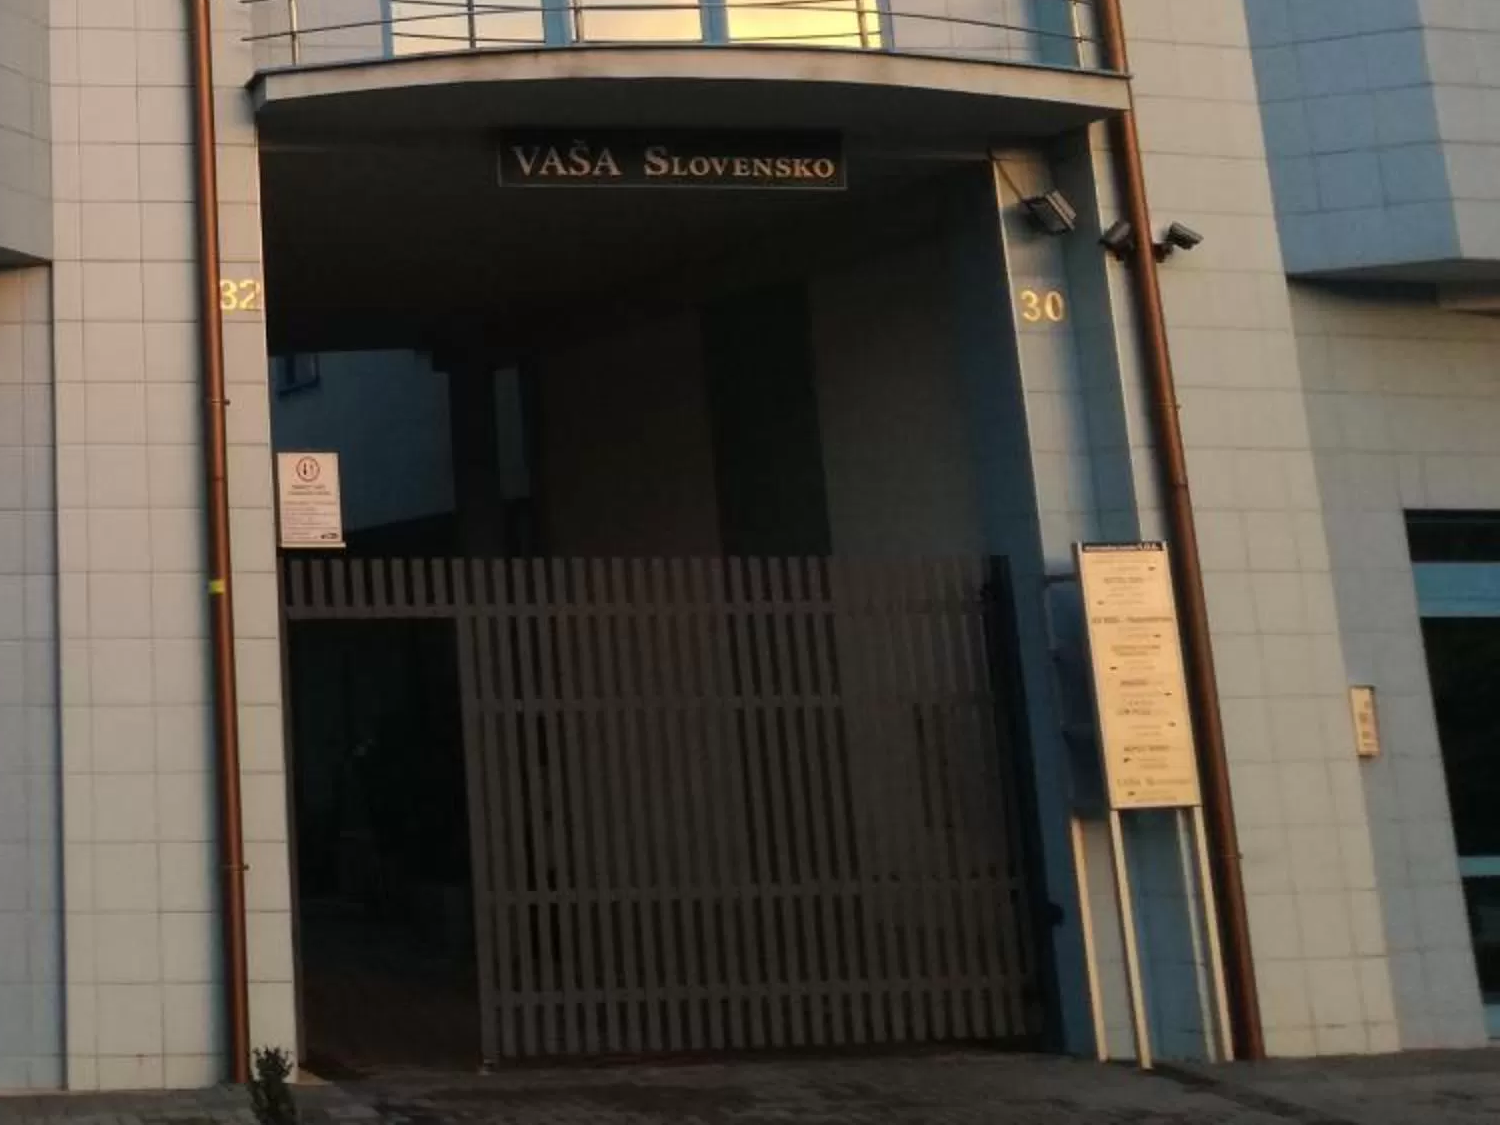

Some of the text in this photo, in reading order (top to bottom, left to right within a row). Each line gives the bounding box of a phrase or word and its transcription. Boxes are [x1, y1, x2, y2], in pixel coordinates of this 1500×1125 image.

[512, 139, 624, 177] VAŠA
[219, 279, 261, 311] 32
[1021, 290, 1064, 322] 30
